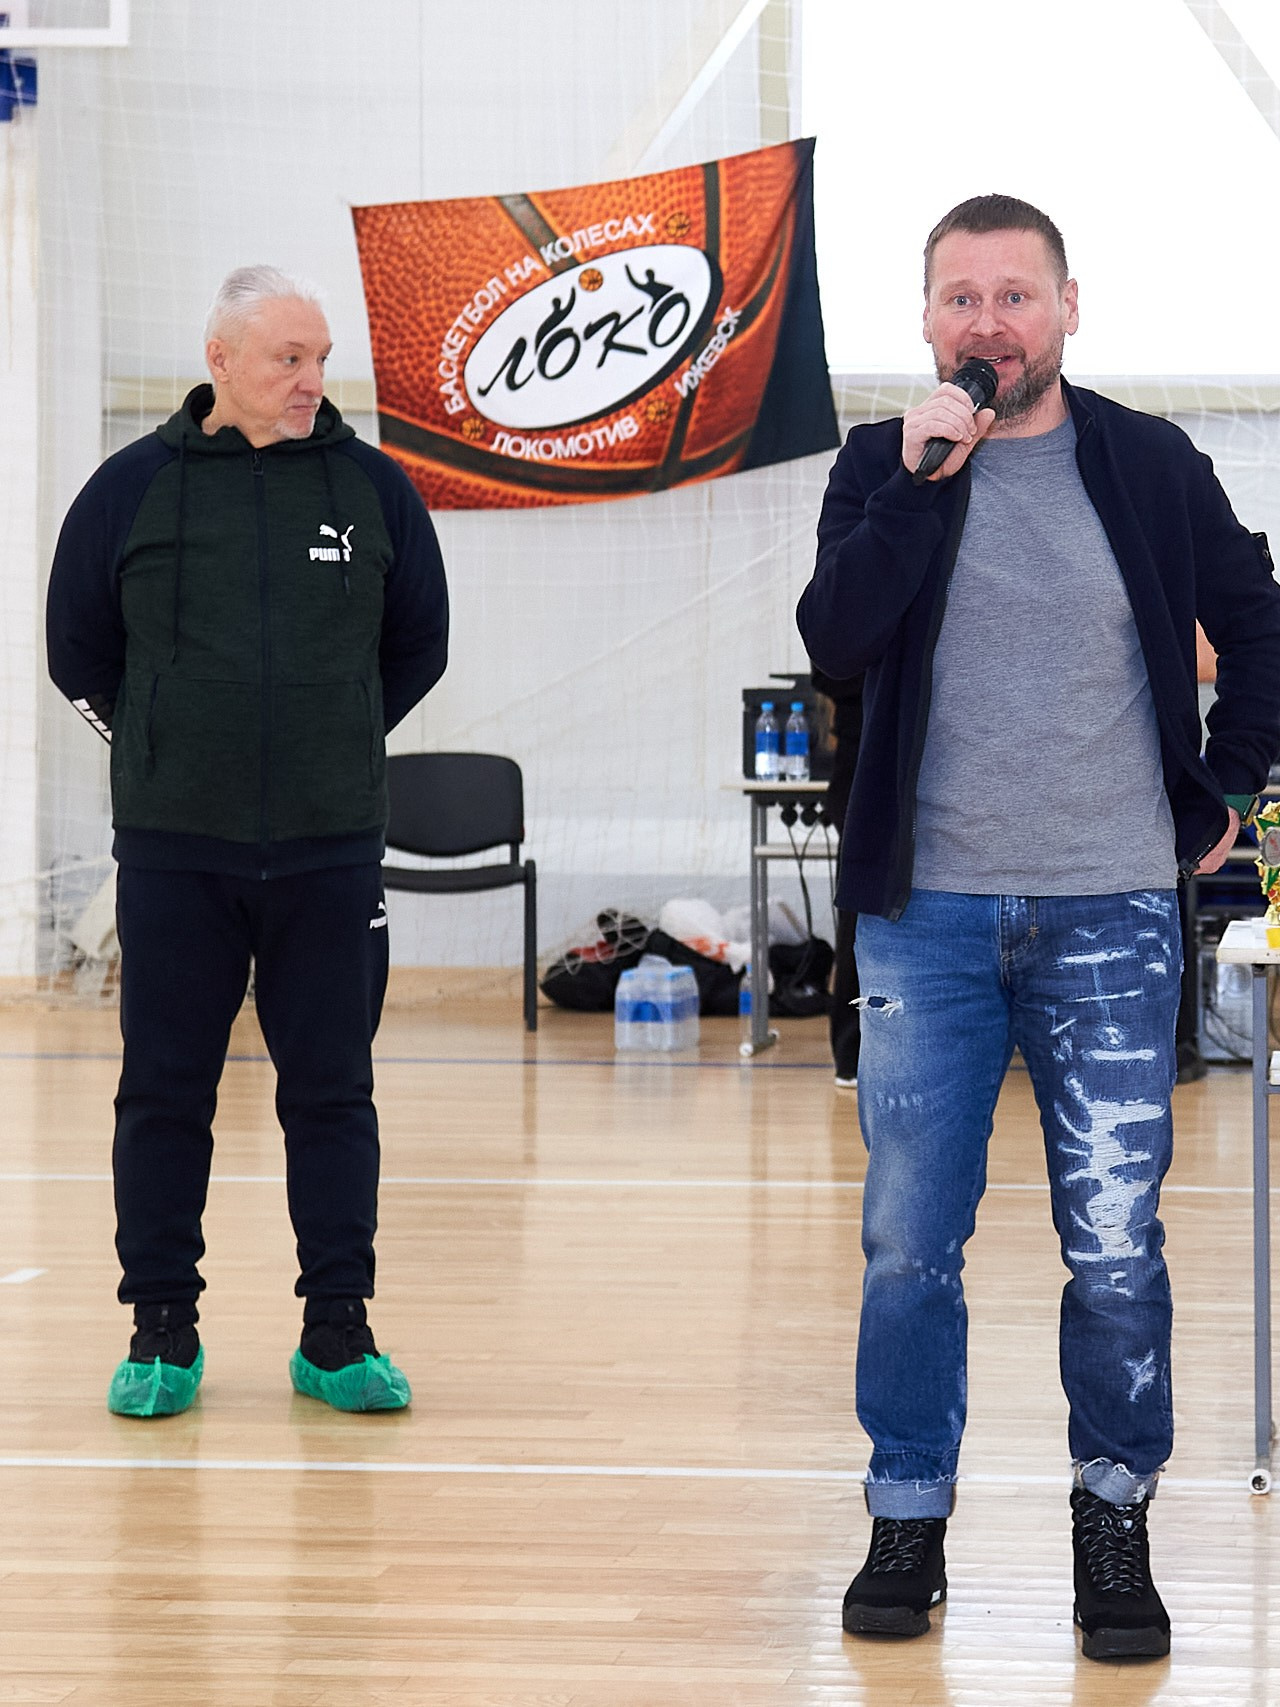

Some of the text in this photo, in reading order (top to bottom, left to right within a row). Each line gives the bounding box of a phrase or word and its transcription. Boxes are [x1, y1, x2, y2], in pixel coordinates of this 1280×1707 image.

[438, 212, 656, 415] БАСКЕТБОЛ НА КОЛЕСАХ
[674, 305, 743, 399] ИЖЕВСК
[490, 414, 640, 460] ЛОКОМОТИВ
